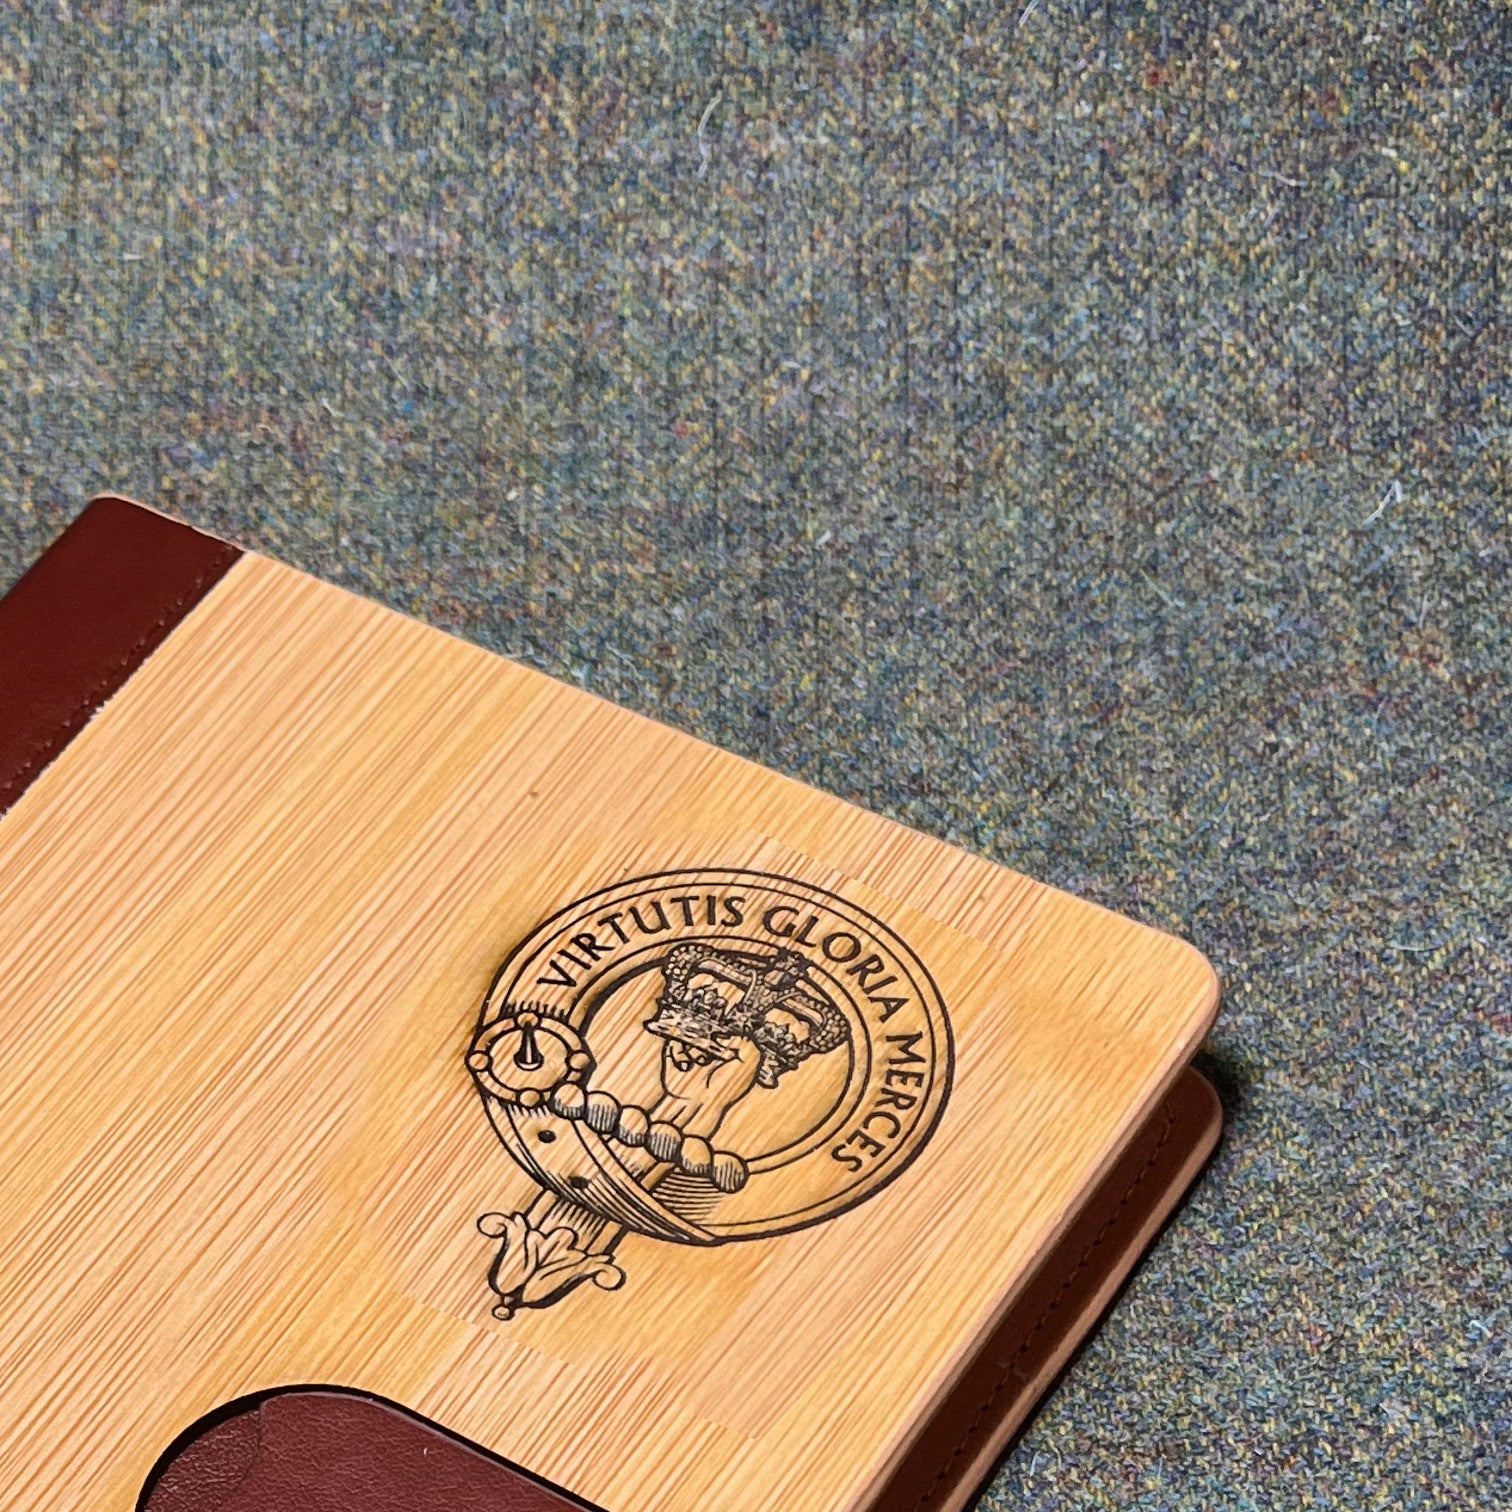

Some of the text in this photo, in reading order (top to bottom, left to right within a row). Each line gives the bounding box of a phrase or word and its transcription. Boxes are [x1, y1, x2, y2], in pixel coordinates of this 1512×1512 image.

[536, 895, 927, 1173] VIRTUTIS GLORIA MERCES
